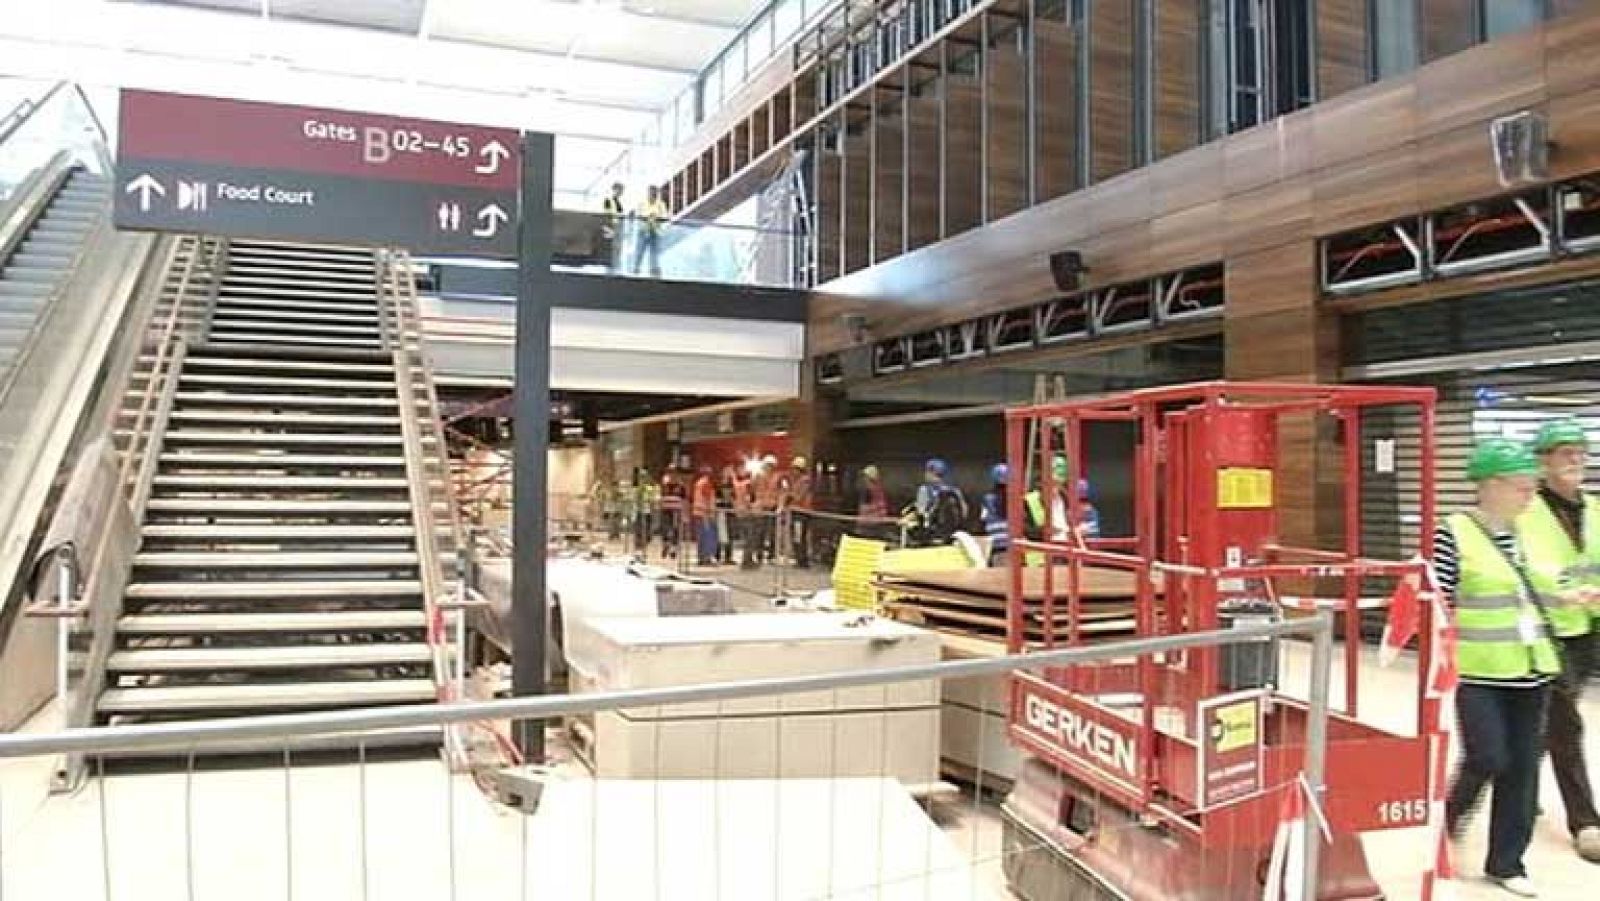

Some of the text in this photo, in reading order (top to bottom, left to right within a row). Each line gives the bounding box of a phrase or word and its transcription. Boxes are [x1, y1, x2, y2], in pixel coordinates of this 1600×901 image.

[303, 119, 357, 142] Gates
[364, 126, 390, 163] B
[218, 182, 314, 206] Food Court
[1025, 690, 1137, 778] GERKEN
[1377, 799, 1427, 824] 1615
